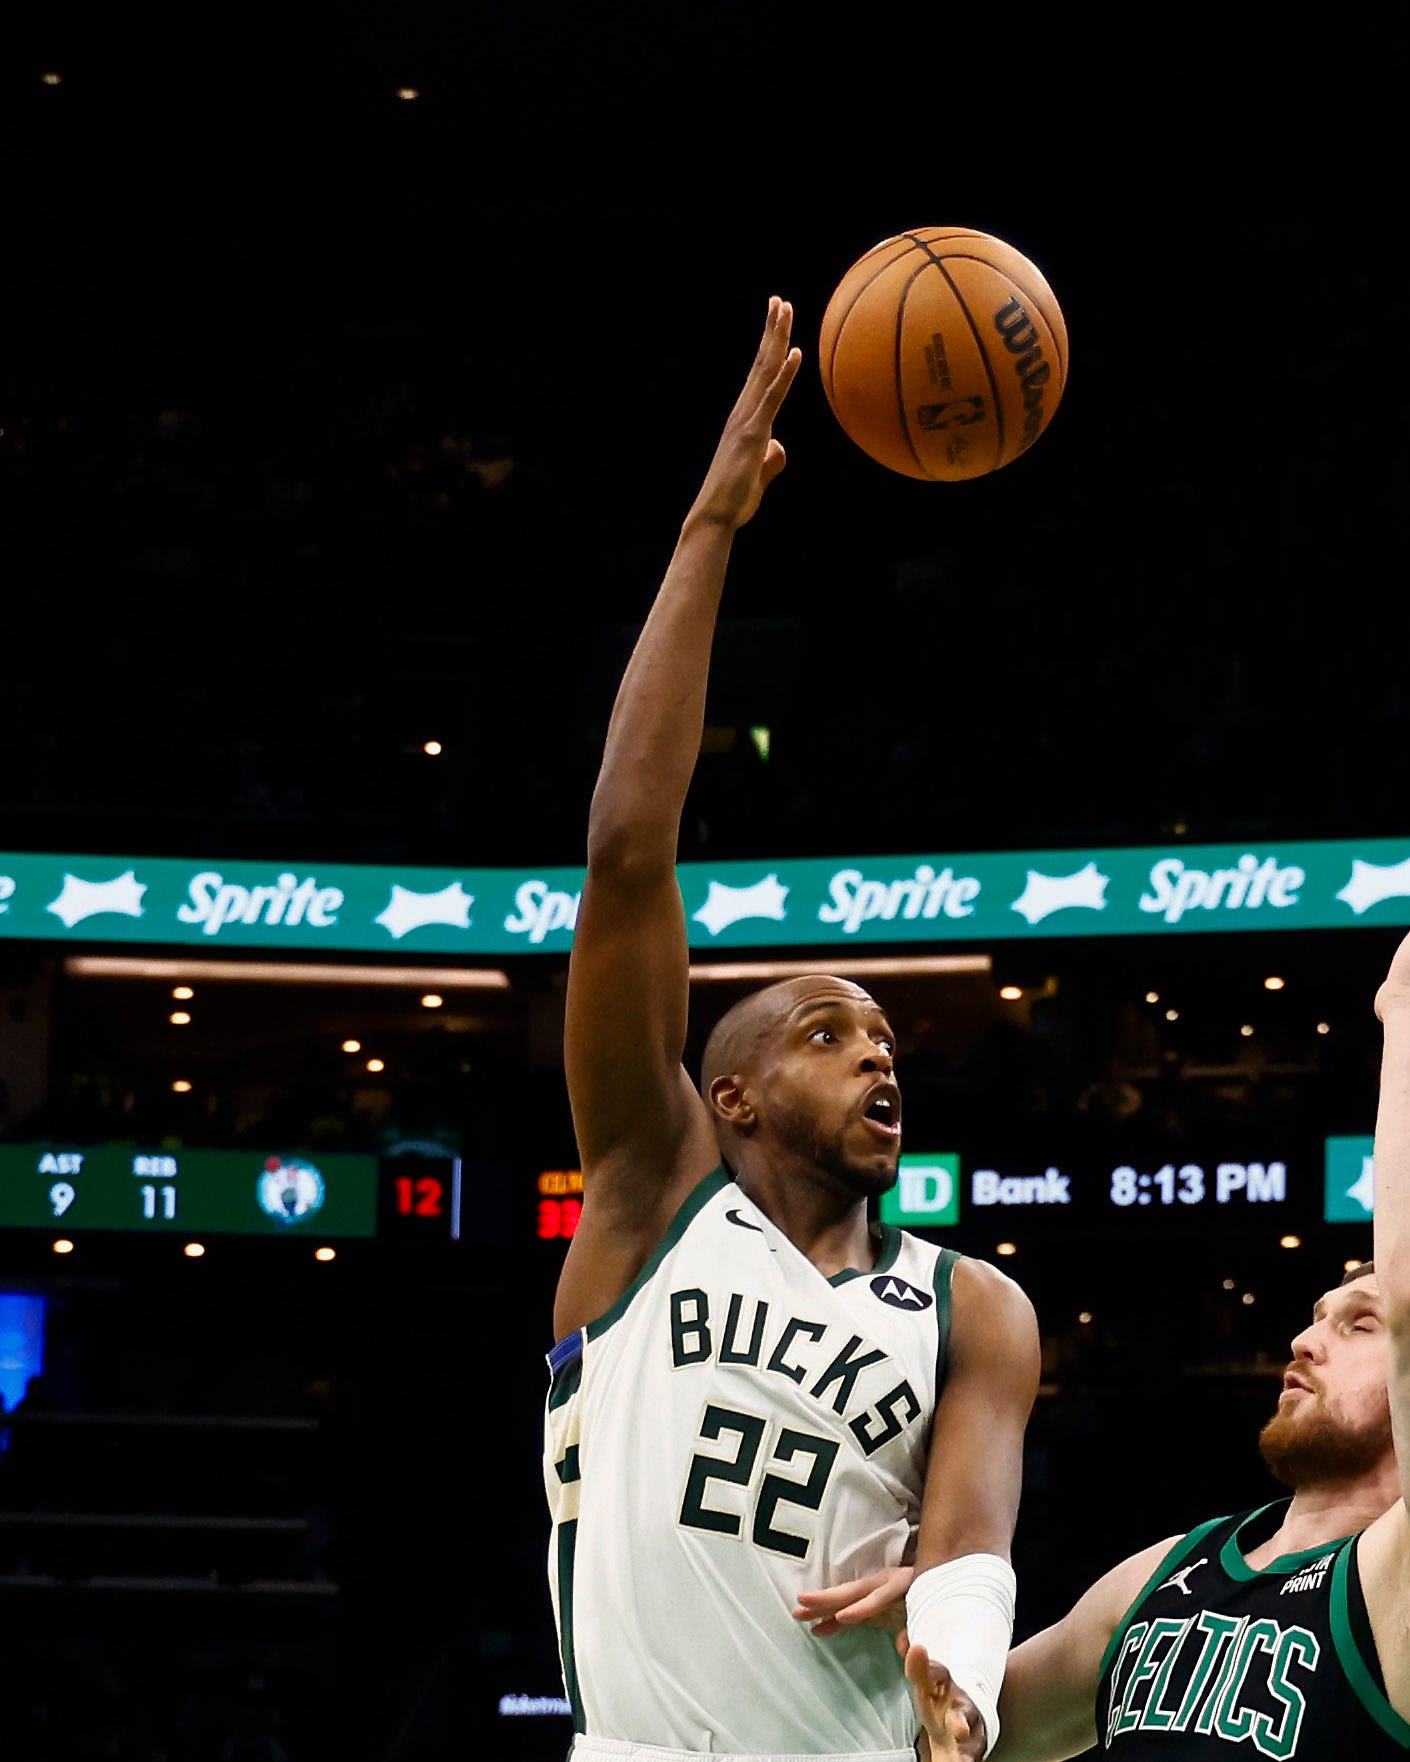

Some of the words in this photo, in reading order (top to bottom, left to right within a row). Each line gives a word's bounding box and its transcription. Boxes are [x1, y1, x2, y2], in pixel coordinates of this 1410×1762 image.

[176, 871, 344, 935] Sprite
[819, 866, 981, 933] Sprite
[1139, 854, 1304, 924] Sprite
[50, 1181, 76, 1217] 9
[140, 1184, 177, 1219] 11
[396, 1177, 443, 1217] 12
[899, 1166, 953, 1213] TD
[971, 1167, 1071, 1206] Bank
[1110, 1164, 1206, 1206] 8:13
[1216, 1162, 1288, 1204] PM
[670, 1288, 922, 1457] BUCKS
[676, 1402, 845, 1560] 22
[1279, 1570, 1327, 1596] PRINT
[1105, 1609, 1320, 1761] CELTICS
